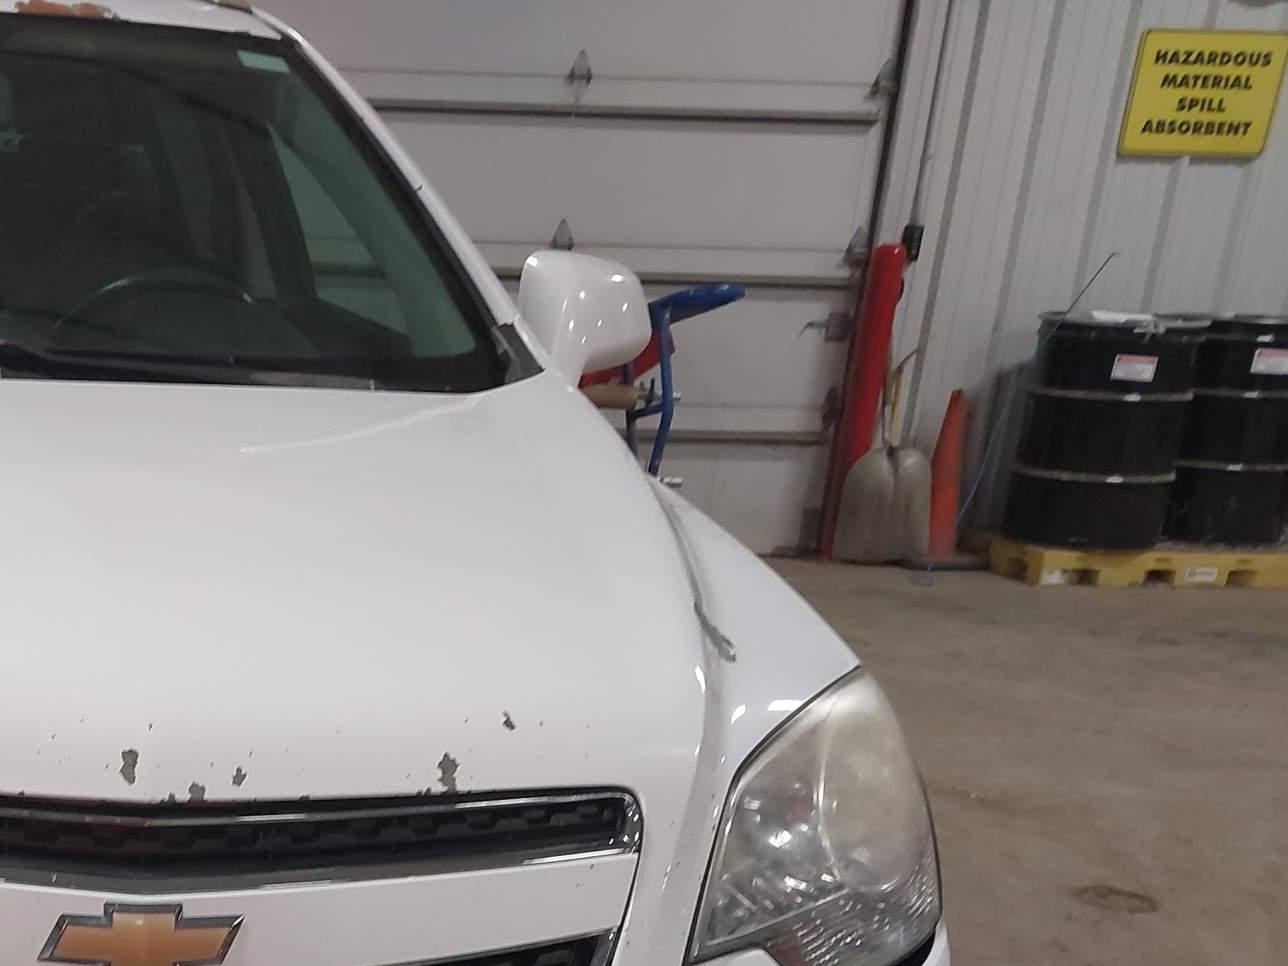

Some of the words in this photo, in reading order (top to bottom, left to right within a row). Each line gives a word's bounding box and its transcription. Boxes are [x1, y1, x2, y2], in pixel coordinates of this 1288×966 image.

[1154, 50, 1272, 67] HAZARDOUS
[1160, 73, 1253, 90] MATERIAL
[1175, 98, 1226, 112] SPILL
[1140, 119, 1252, 136] ABSORBENT
